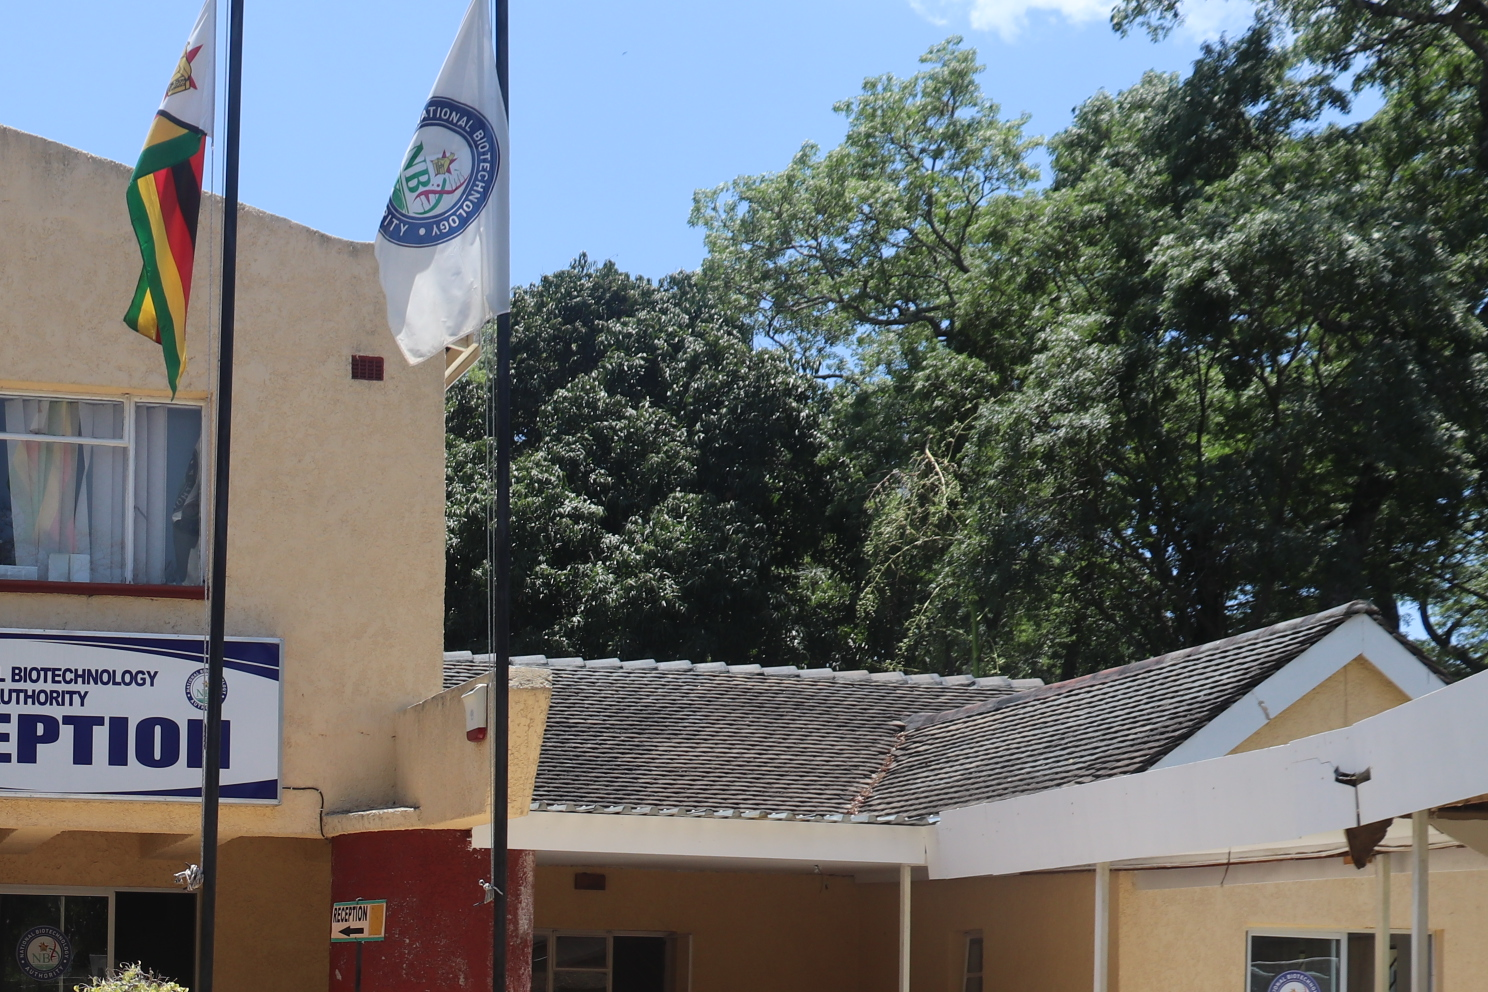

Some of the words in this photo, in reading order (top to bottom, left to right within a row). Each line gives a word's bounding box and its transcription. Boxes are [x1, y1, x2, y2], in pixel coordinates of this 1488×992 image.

[420, 106, 475, 132] ATIONAL
[431, 129, 491, 237] BIOTECHNOLOGY
[11, 666, 160, 687] BIOTECHNOLOGY
[333, 906, 368, 923] RECEPTION
[25, 966, 64, 979] AUTHORITY
